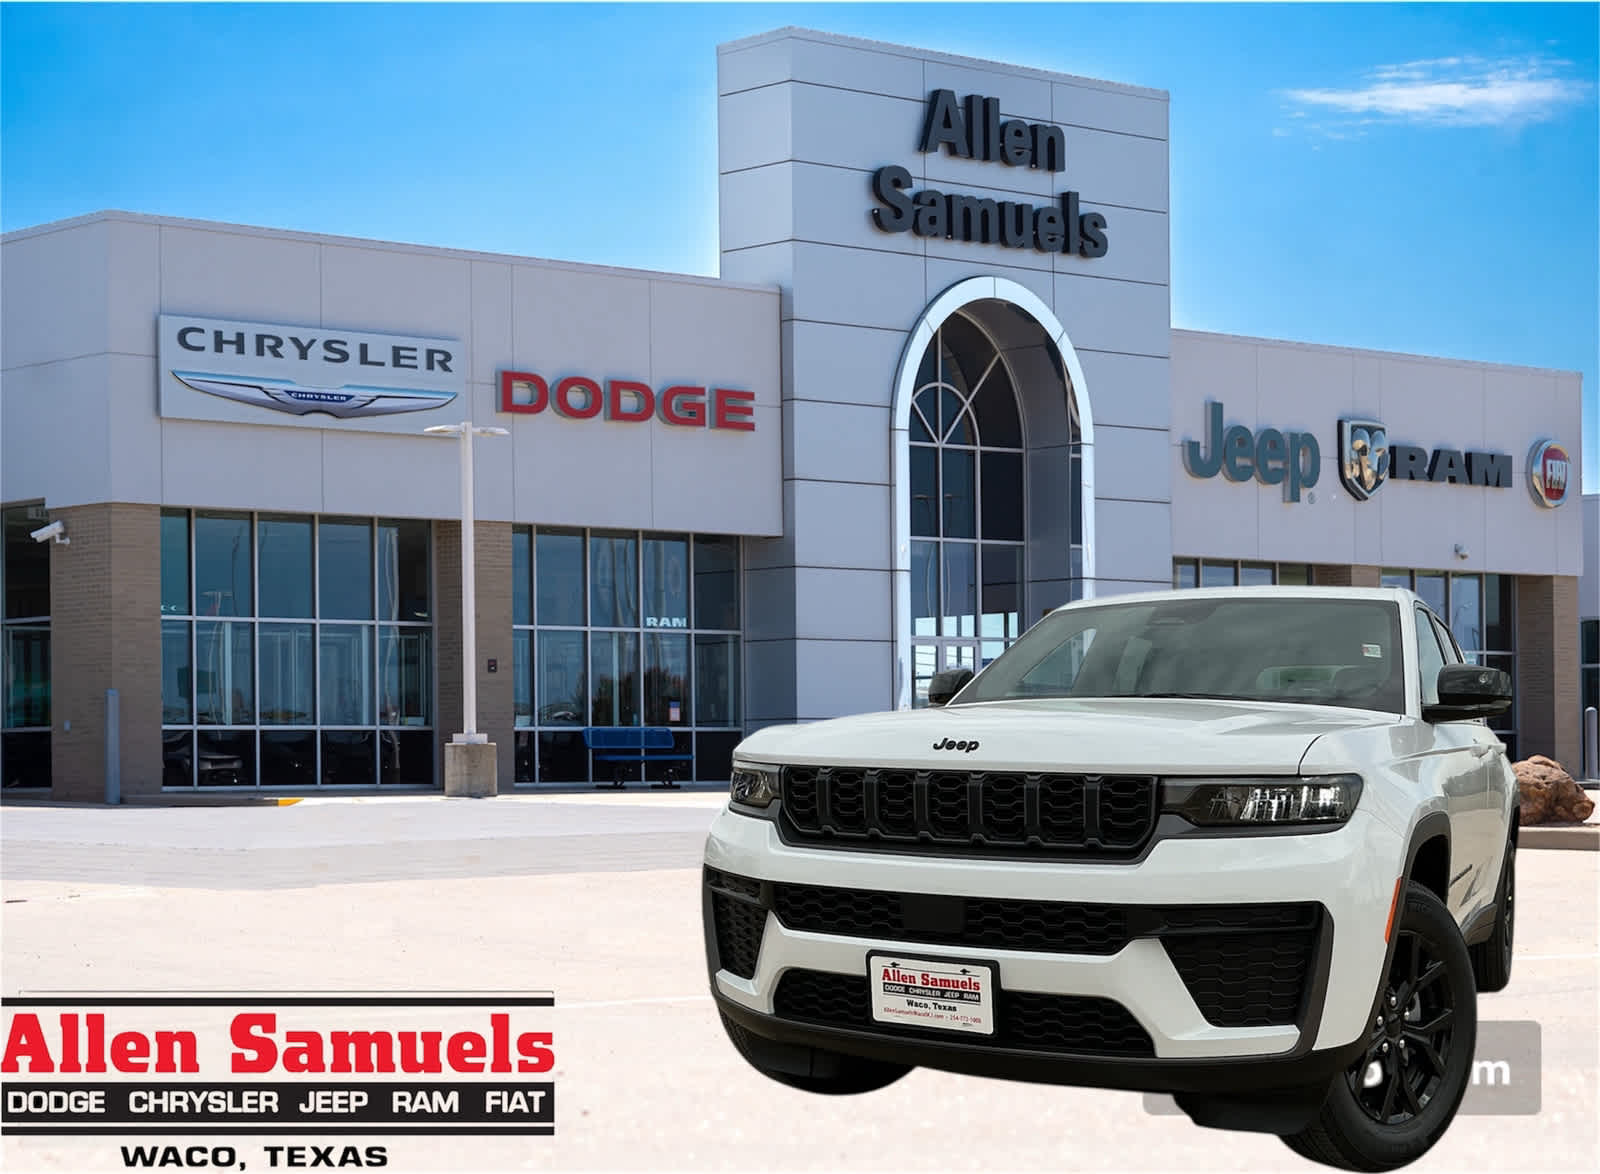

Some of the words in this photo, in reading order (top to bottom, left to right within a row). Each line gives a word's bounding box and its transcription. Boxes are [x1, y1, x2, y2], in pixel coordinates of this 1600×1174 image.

[919, 89, 1066, 171] Allen
[872, 165, 1108, 258] Samuels
[177, 326, 454, 373] CHRYSLER
[497, 371, 755, 432] DODGE
[1182, 401, 1320, 503] Jeep
[1389, 445, 1513, 488] RAM
[1546, 459, 1567, 489] FIAT
[646, 616, 687, 628] RAM
[933, 737, 980, 753] Jeep
[882, 968, 916, 984] Allen
[921, 973, 981, 991] Samuels
[884, 984, 906, 993] DODGE
[908, 987, 941, 997] CHRYSLER
[944, 991, 960, 999] JEEP
[963, 993, 979, 1001] RAM
[906, 999, 931, 1010] Waco,
[932, 1002, 957, 1012] Texas
